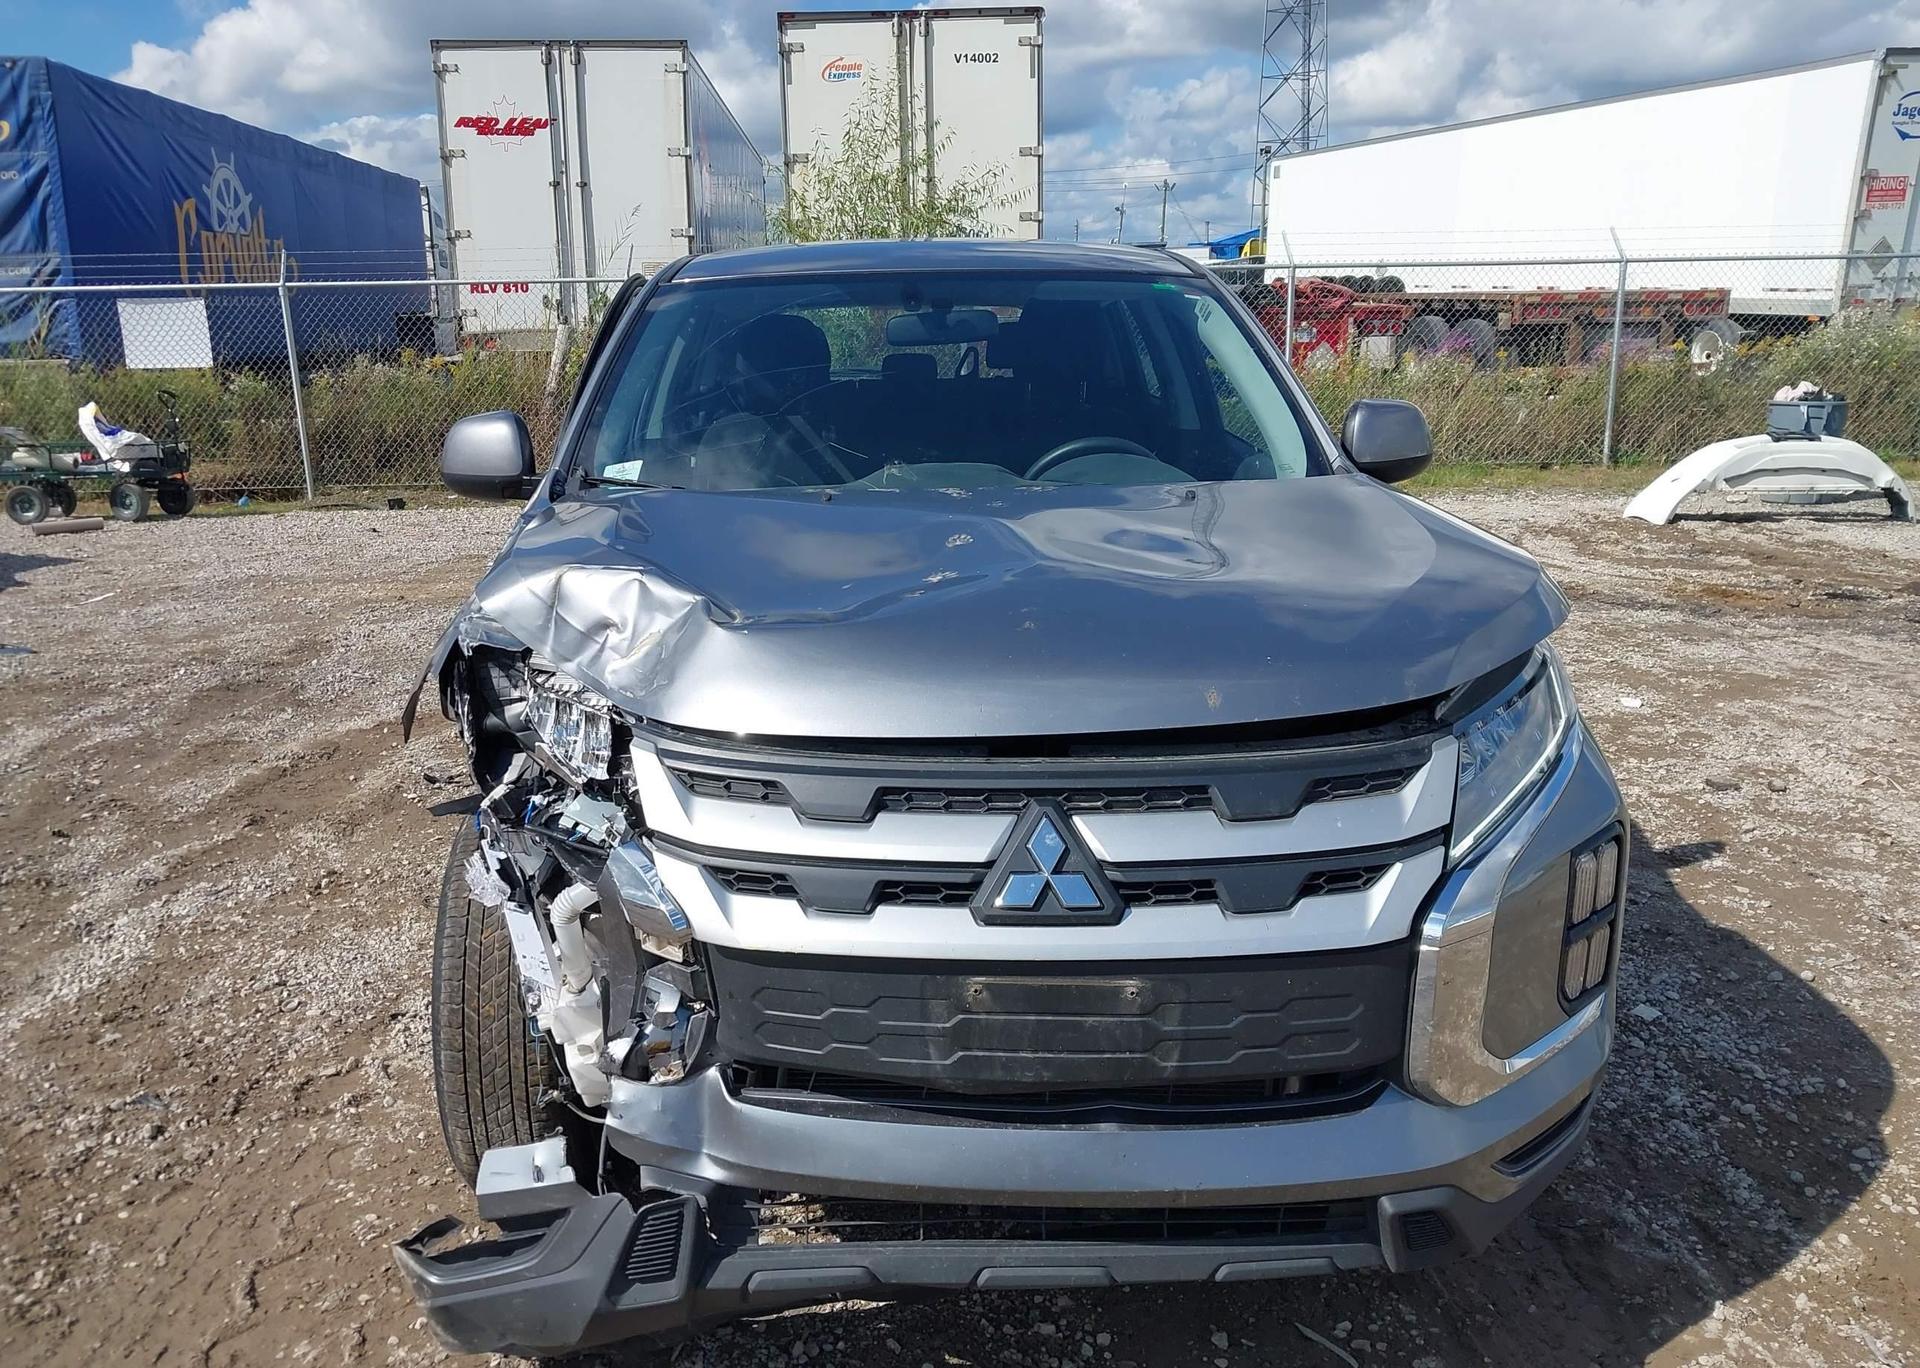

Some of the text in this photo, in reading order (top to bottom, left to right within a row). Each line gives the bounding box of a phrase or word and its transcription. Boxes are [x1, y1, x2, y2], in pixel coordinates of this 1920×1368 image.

[953, 52, 999, 64] V14002
[829, 62, 863, 72] People
[828, 71, 862, 80] Express
[454, 116, 500, 128] RED
[1869, 177, 1909, 190] HIRING!
[470, 282, 529, 294] RLV 810
